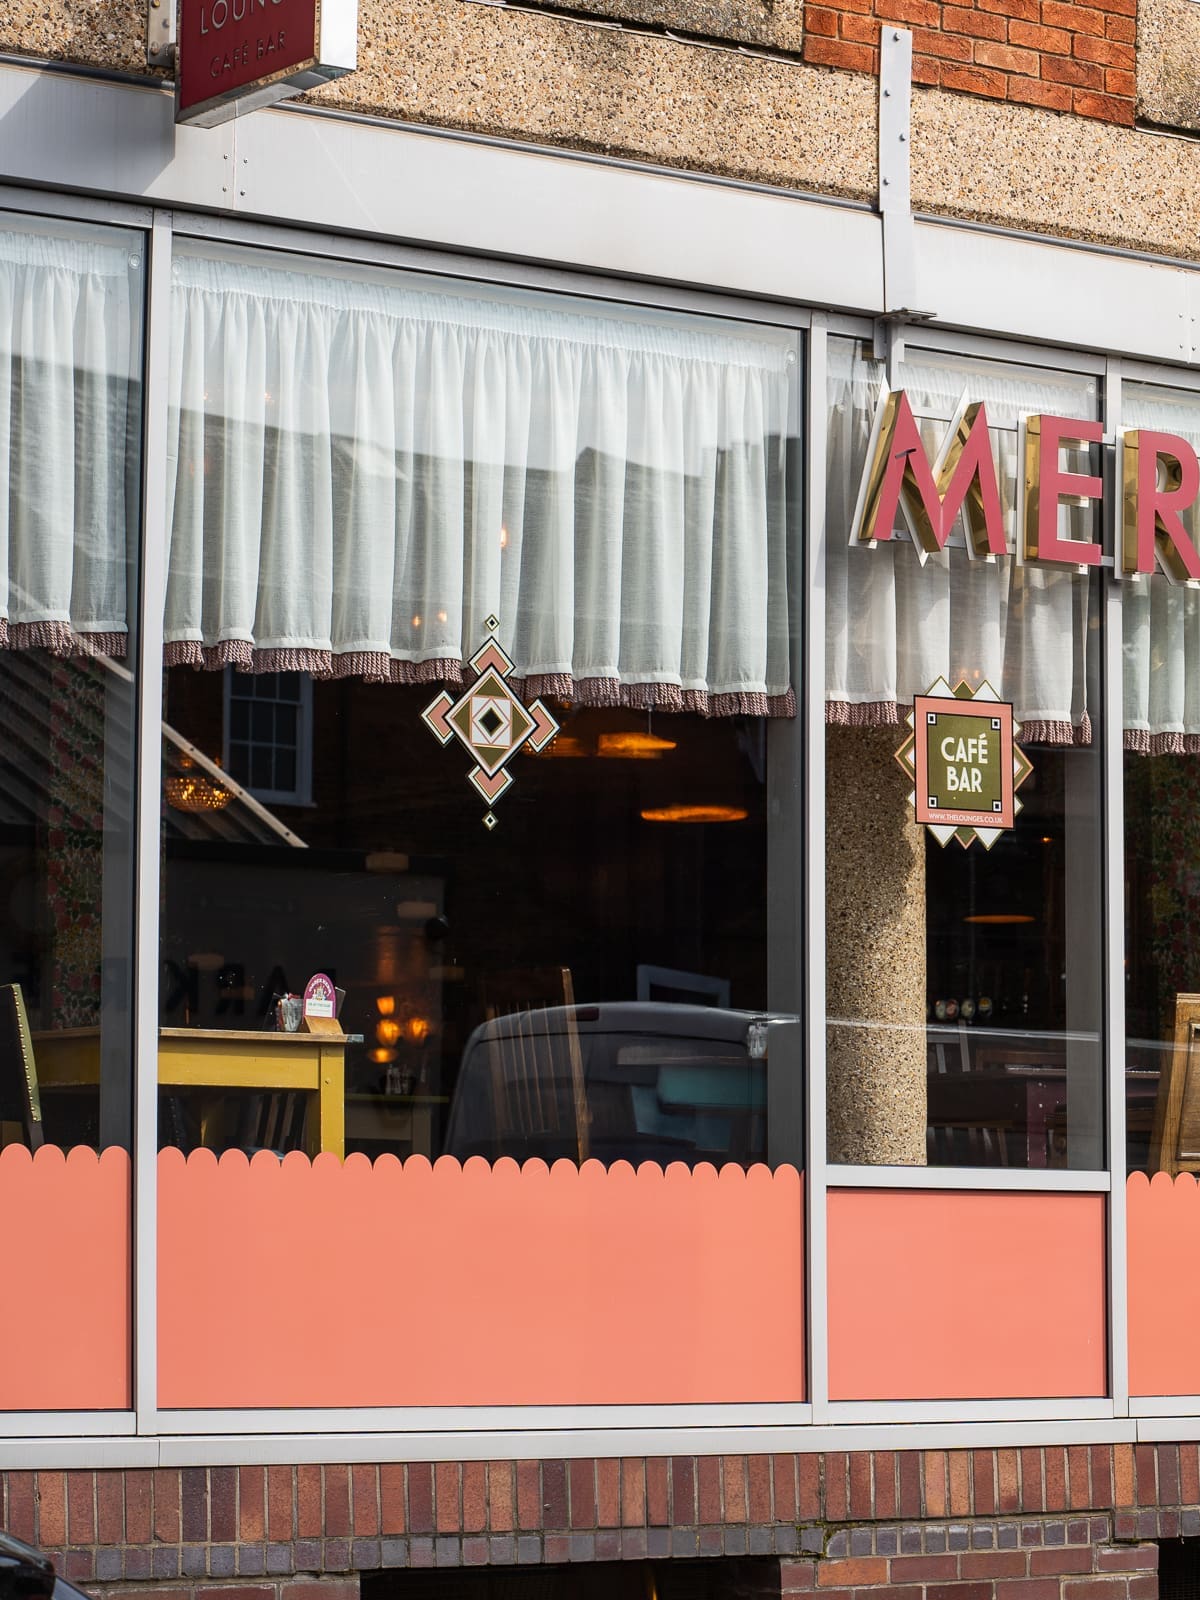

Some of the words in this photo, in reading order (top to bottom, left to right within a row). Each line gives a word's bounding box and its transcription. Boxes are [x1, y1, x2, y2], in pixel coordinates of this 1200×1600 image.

[210, 40, 249, 77] CAFÉ
[257, 31, 286, 60] BAR
[940, 733, 988, 764] CAFÉ
[946, 766, 983, 793] BAR
[928, 813, 1003, 824] WWW.THELOUNGES.CO.UK
